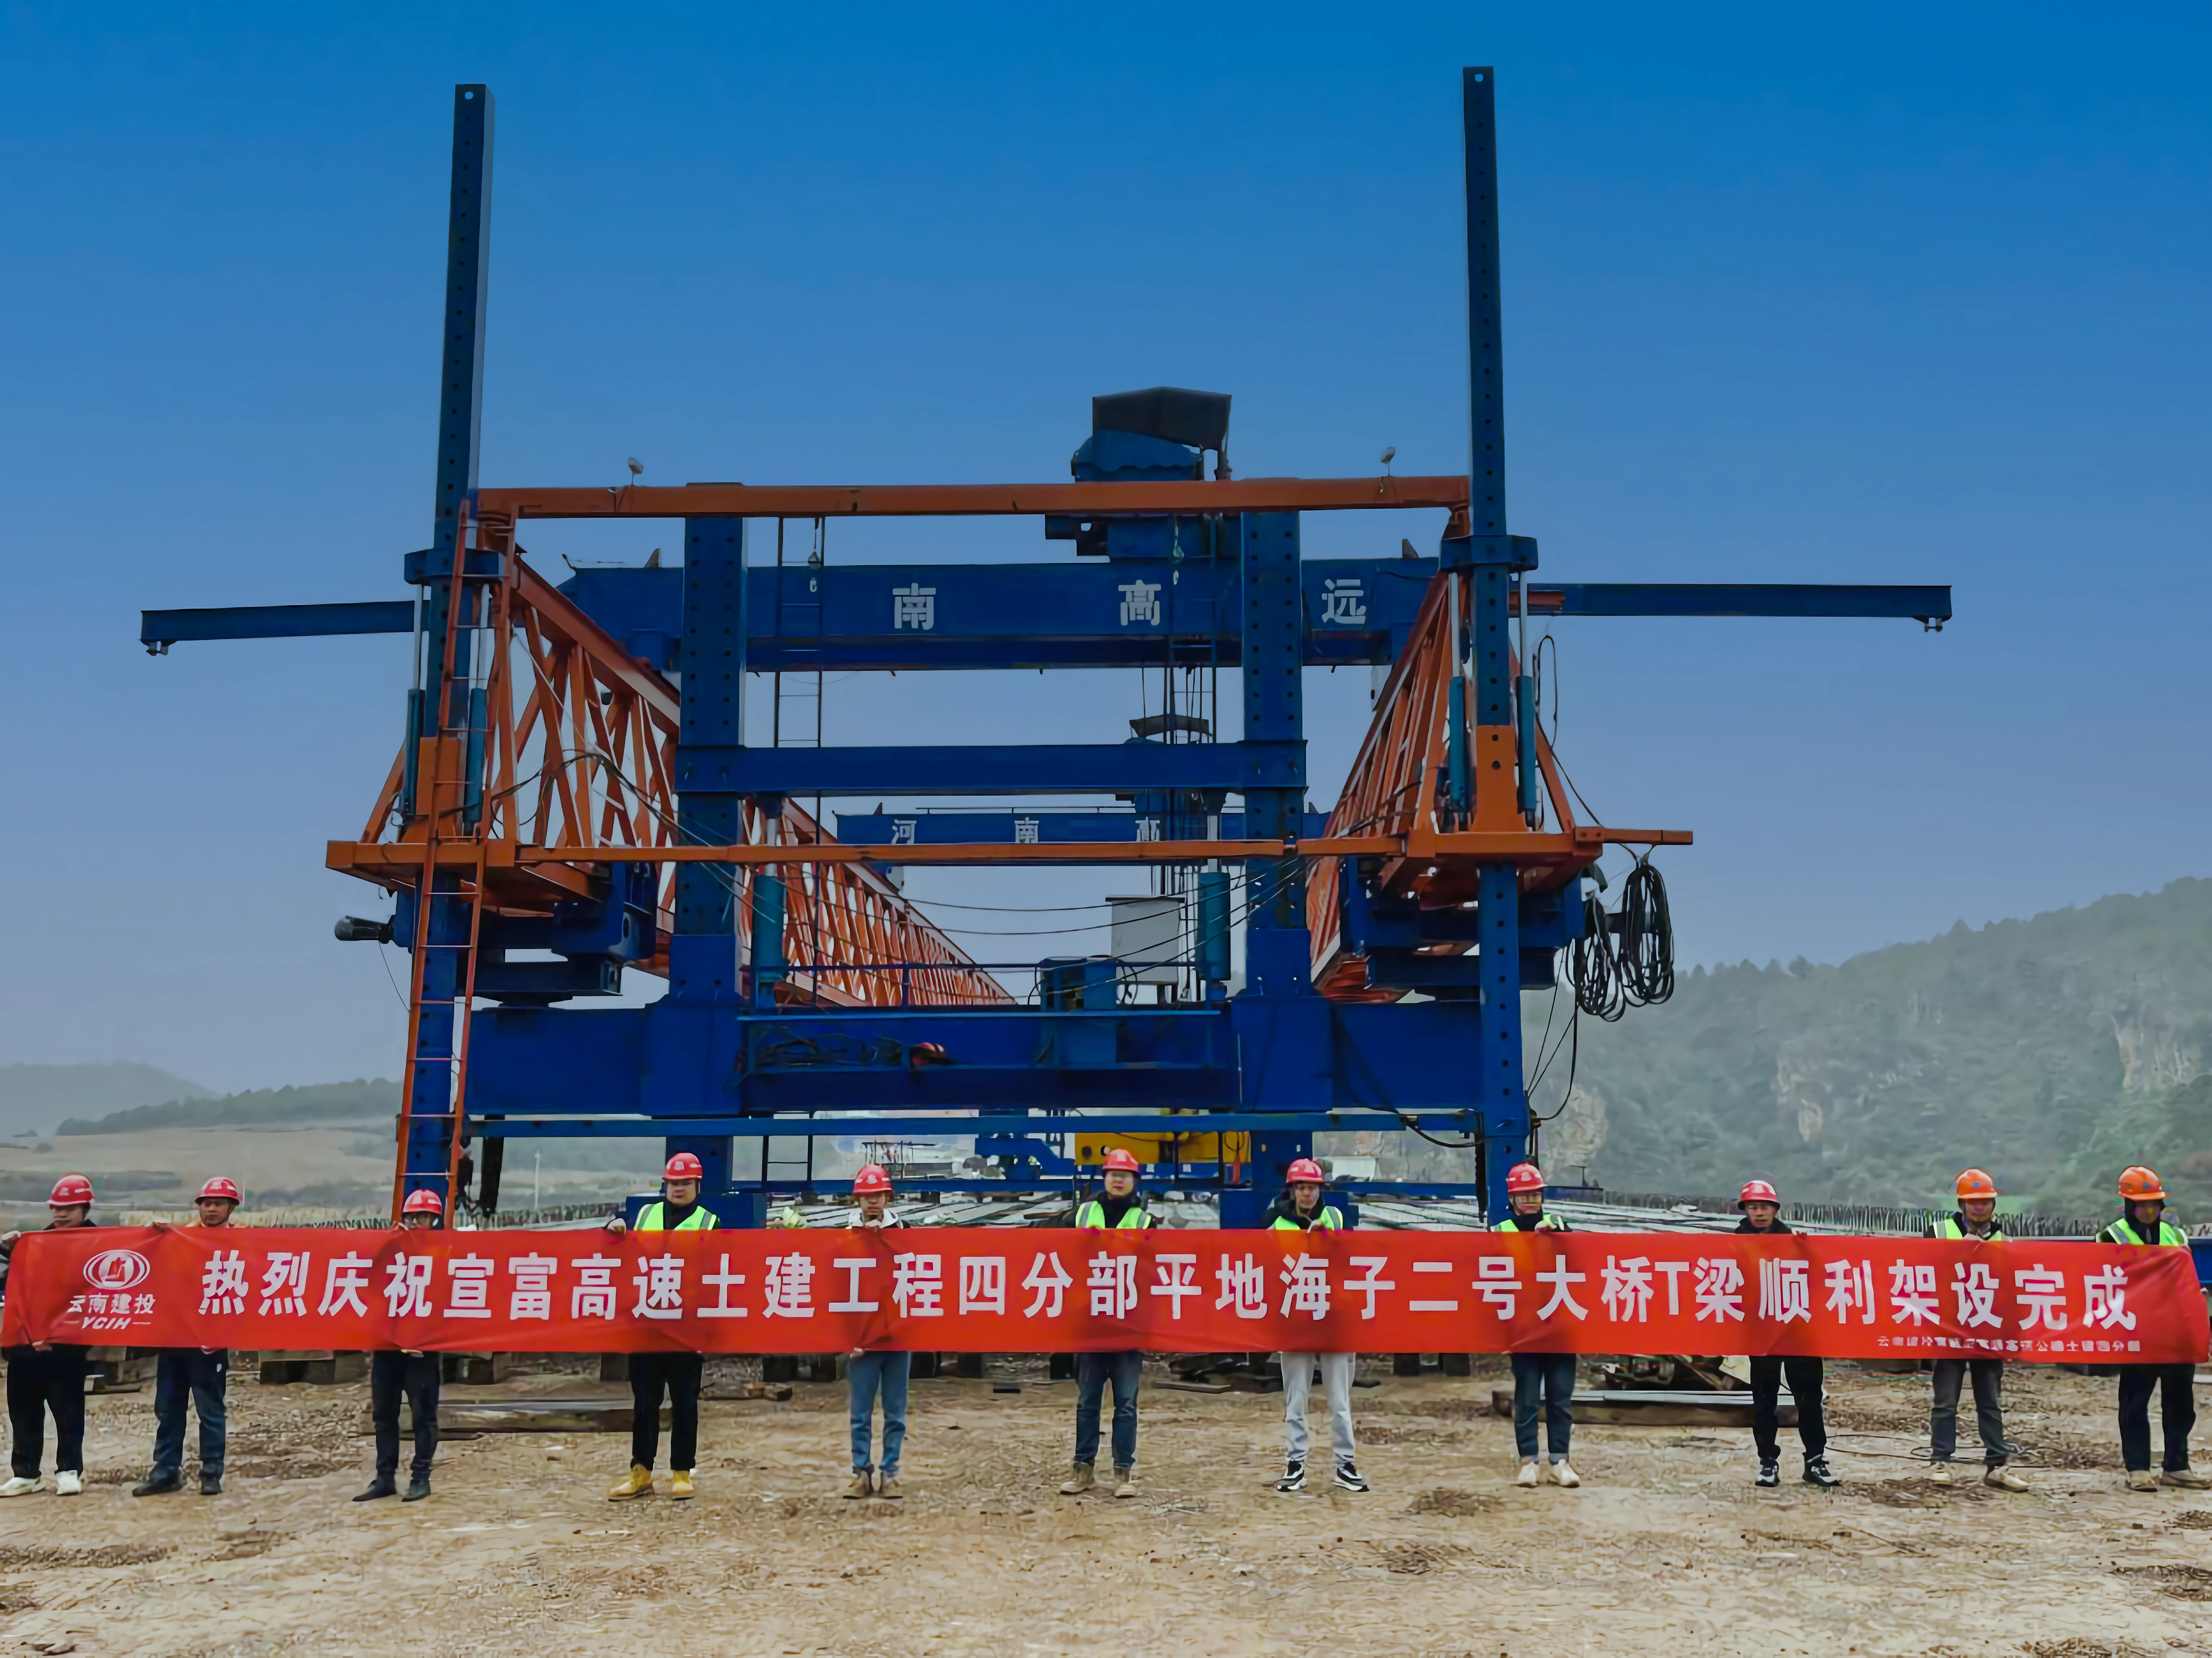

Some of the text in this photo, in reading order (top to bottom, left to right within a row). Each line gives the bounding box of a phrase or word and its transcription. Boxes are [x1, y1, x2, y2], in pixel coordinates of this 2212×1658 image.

[66, 1292, 156, 1314] 云南建投
[198, 1250, 2136, 1332] 热烈庆祝宣富高速土建工程四分部平地海子二号大桥T梁顺利架设完成
